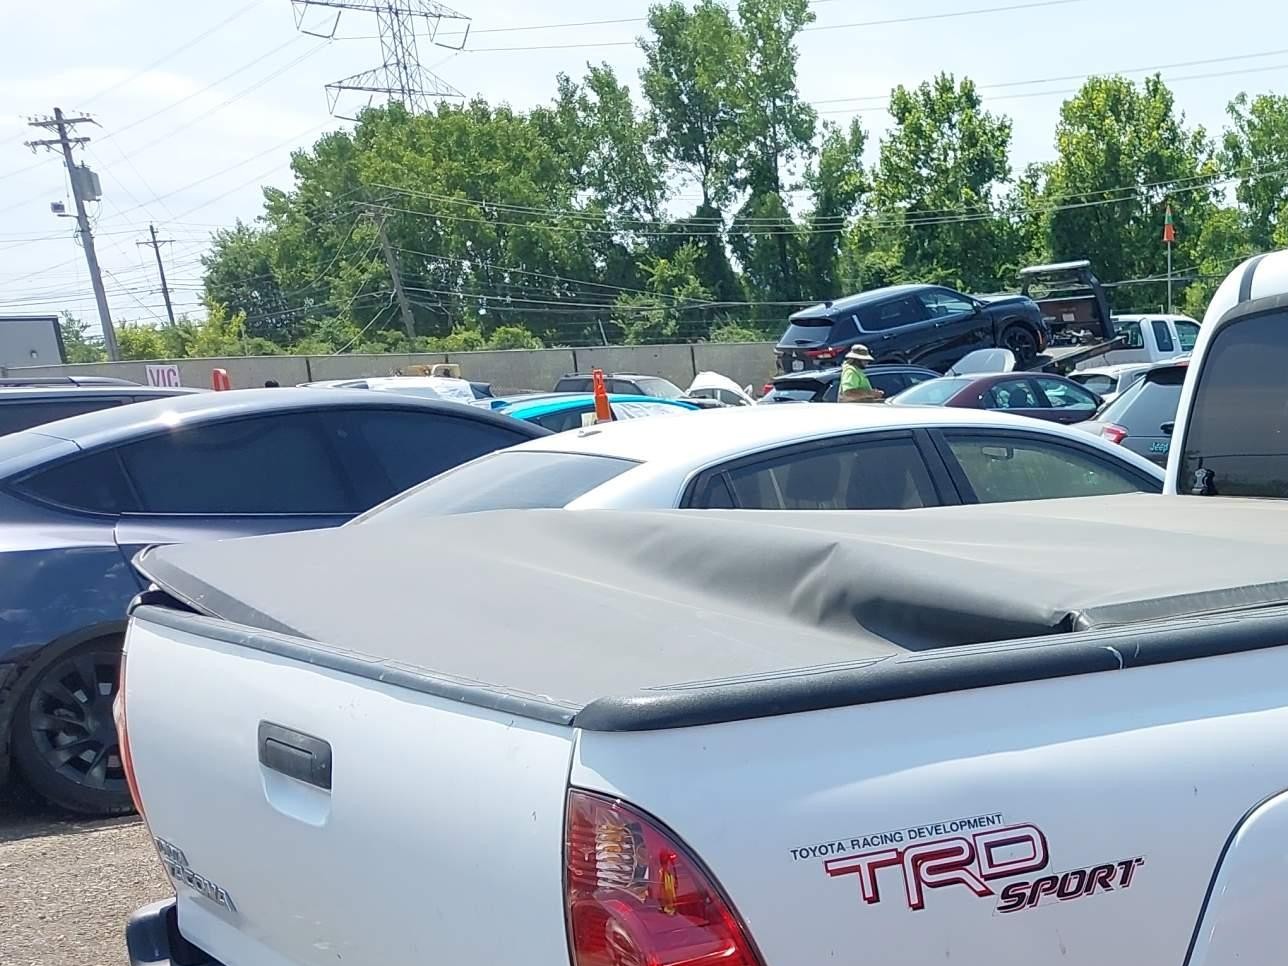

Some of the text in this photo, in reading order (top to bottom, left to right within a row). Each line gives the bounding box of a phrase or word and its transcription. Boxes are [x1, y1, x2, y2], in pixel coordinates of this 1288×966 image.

[1151, 442, 1168, 453] Jeep
[790, 814, 1003, 861] TOYOTA RACING DEVELOPMENT
[824, 823, 1050, 911] TRD
[997, 857, 1146, 914] SPORT
